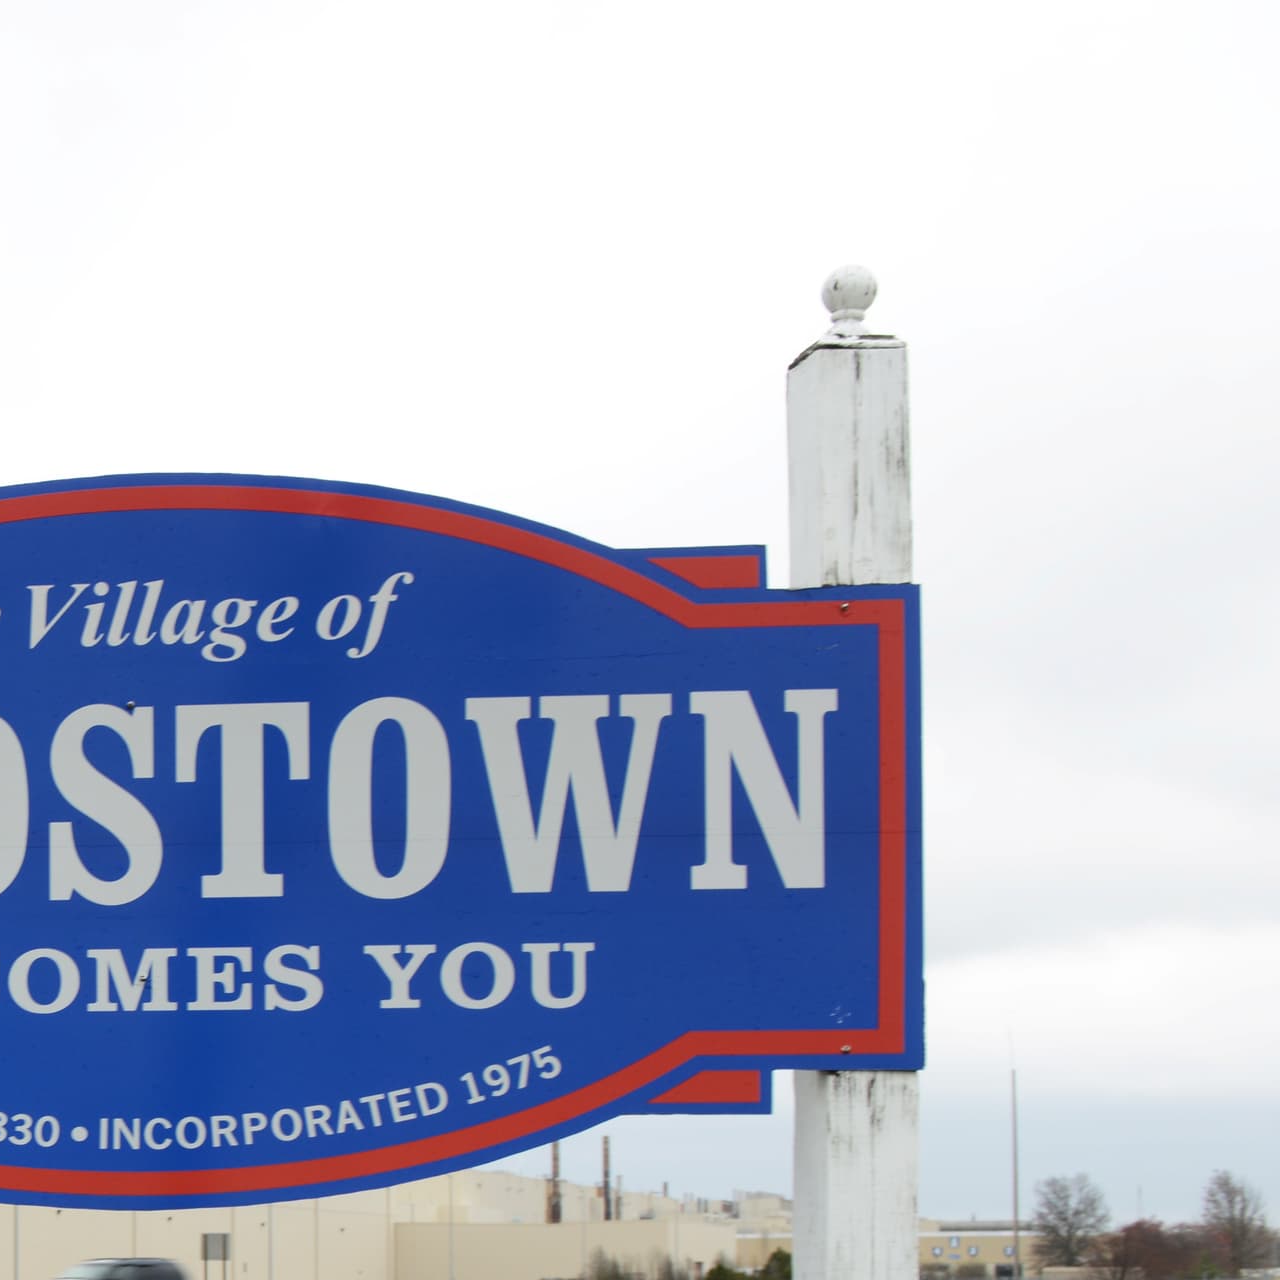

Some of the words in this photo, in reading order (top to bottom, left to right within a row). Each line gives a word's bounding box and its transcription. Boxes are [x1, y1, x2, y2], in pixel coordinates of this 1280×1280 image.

[26, 579, 300, 663] Village
[316, 571, 415, 659] of
[363, 942, 596, 1010] YOU
[98, 1081, 450, 1151] INCORPORATED
[459, 1044, 563, 1105] 1975
